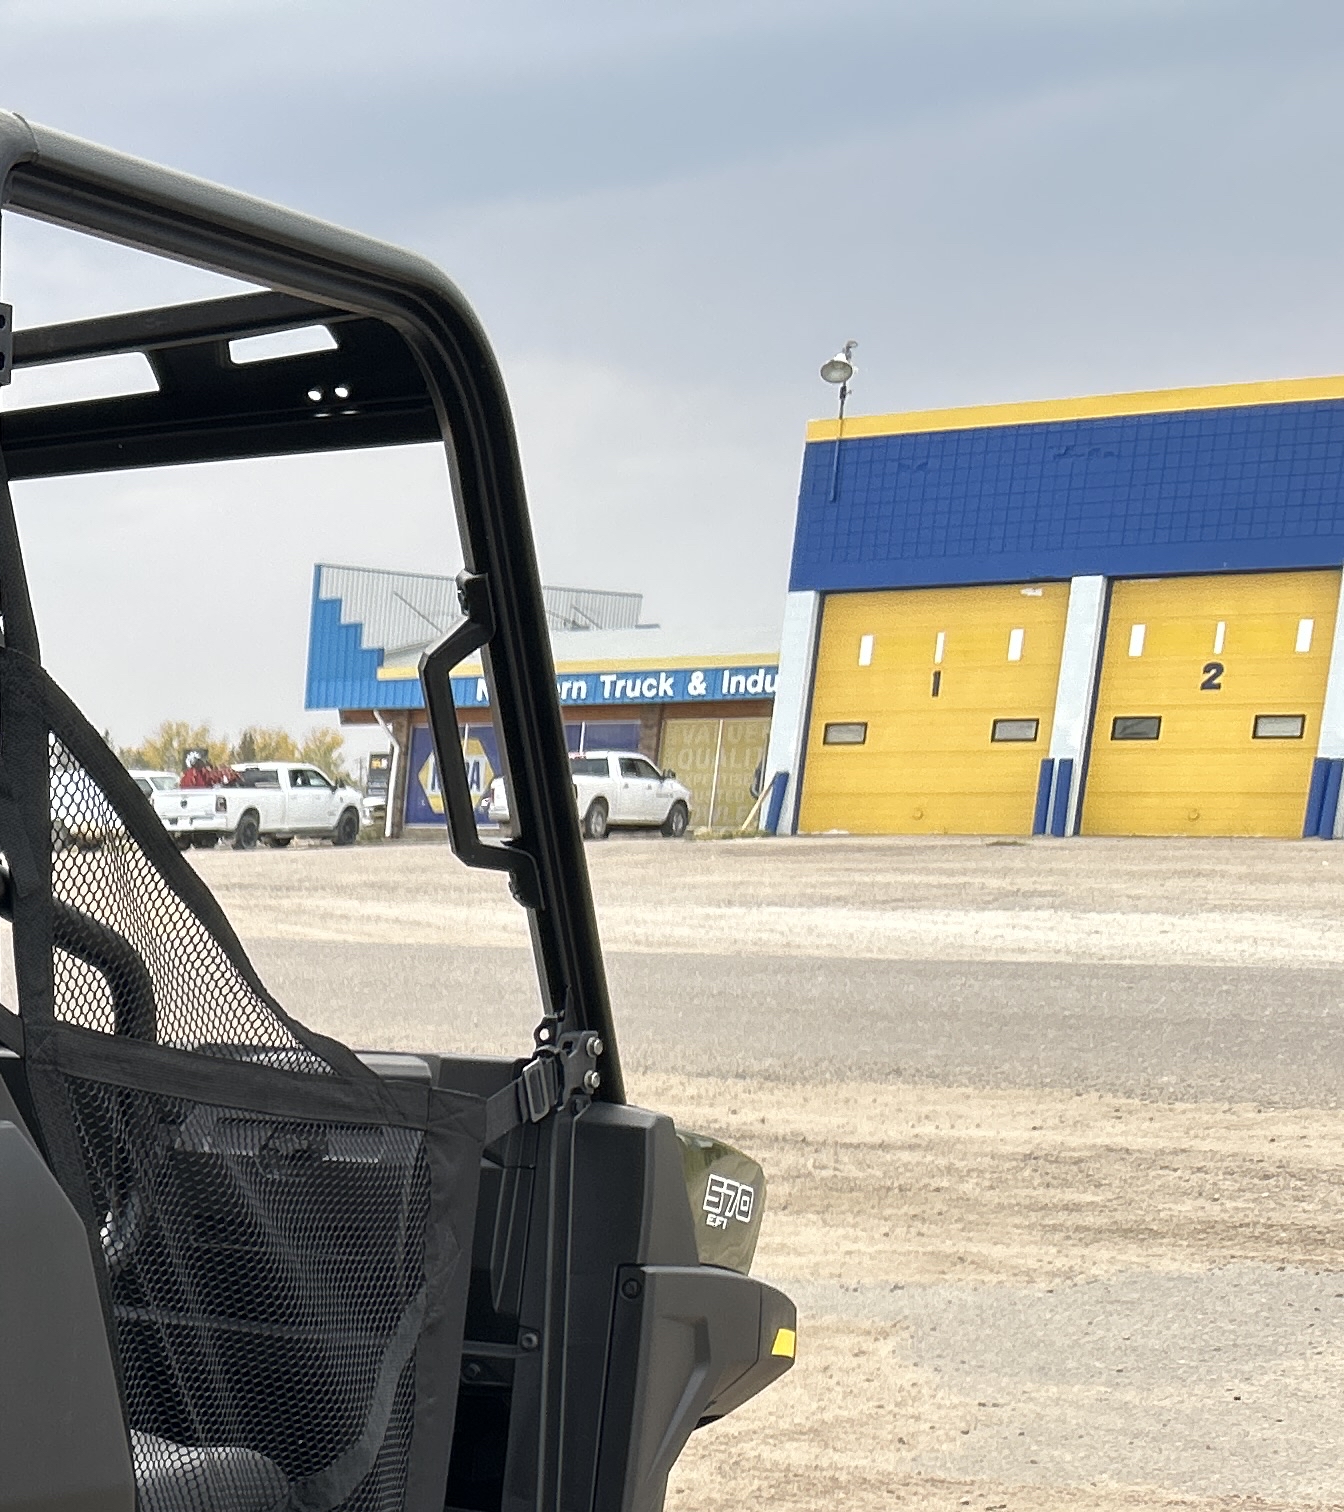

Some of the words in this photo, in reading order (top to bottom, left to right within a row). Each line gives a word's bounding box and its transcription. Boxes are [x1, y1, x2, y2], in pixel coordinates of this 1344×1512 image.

[600, 672, 674, 699] Truck
[687, 671, 707, 696] &
[931, 670, 942, 697] 1
[1200, 662, 1224, 690] 2
[703, 1174, 754, 1223] 570
[706, 1213, 727, 1230] EFI
